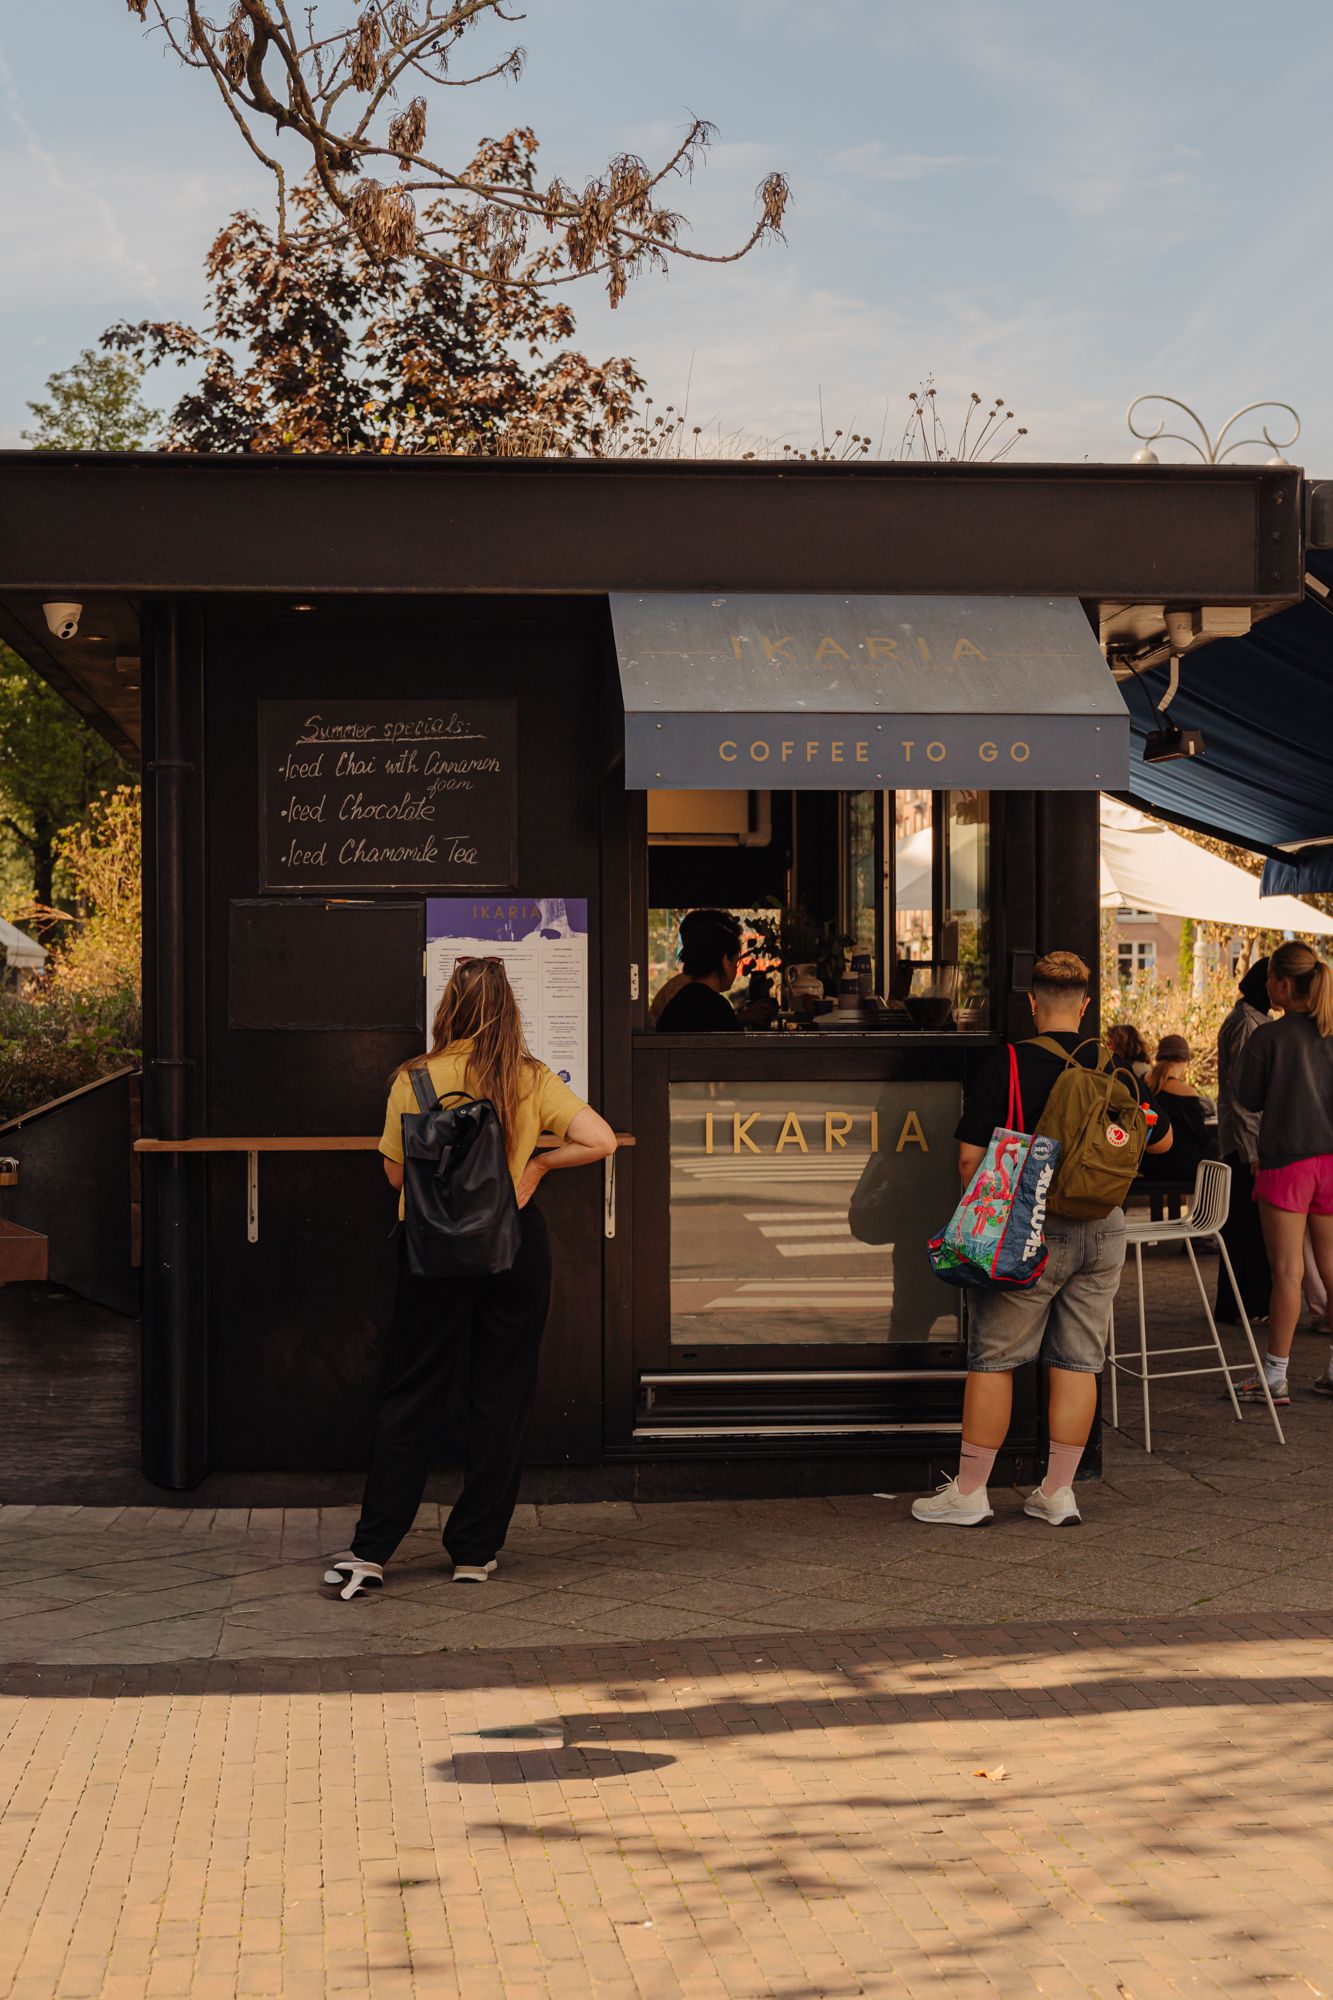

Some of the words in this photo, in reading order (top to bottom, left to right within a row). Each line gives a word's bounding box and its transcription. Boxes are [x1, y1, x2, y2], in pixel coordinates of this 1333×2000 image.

[731, 636, 988, 661] IKARIA
[301, 715, 376, 741] Summer
[335, 751, 377, 777] Chai
[385, 749, 420, 775] with
[424, 751, 501, 776] Cinnamon
[719, 740, 869, 762] COFFEE
[902, 740, 946, 762] TO
[979, 740, 1031, 762] GO
[427, 776, 474, 799] foam
[338, 792, 436, 822] Chocolate
[338, 834, 438, 864] Chamomile
[443, 835, 479, 864] Tea
[472, 904, 541, 919] IKARIA
[705, 1110, 929, 1153] IKARIA
